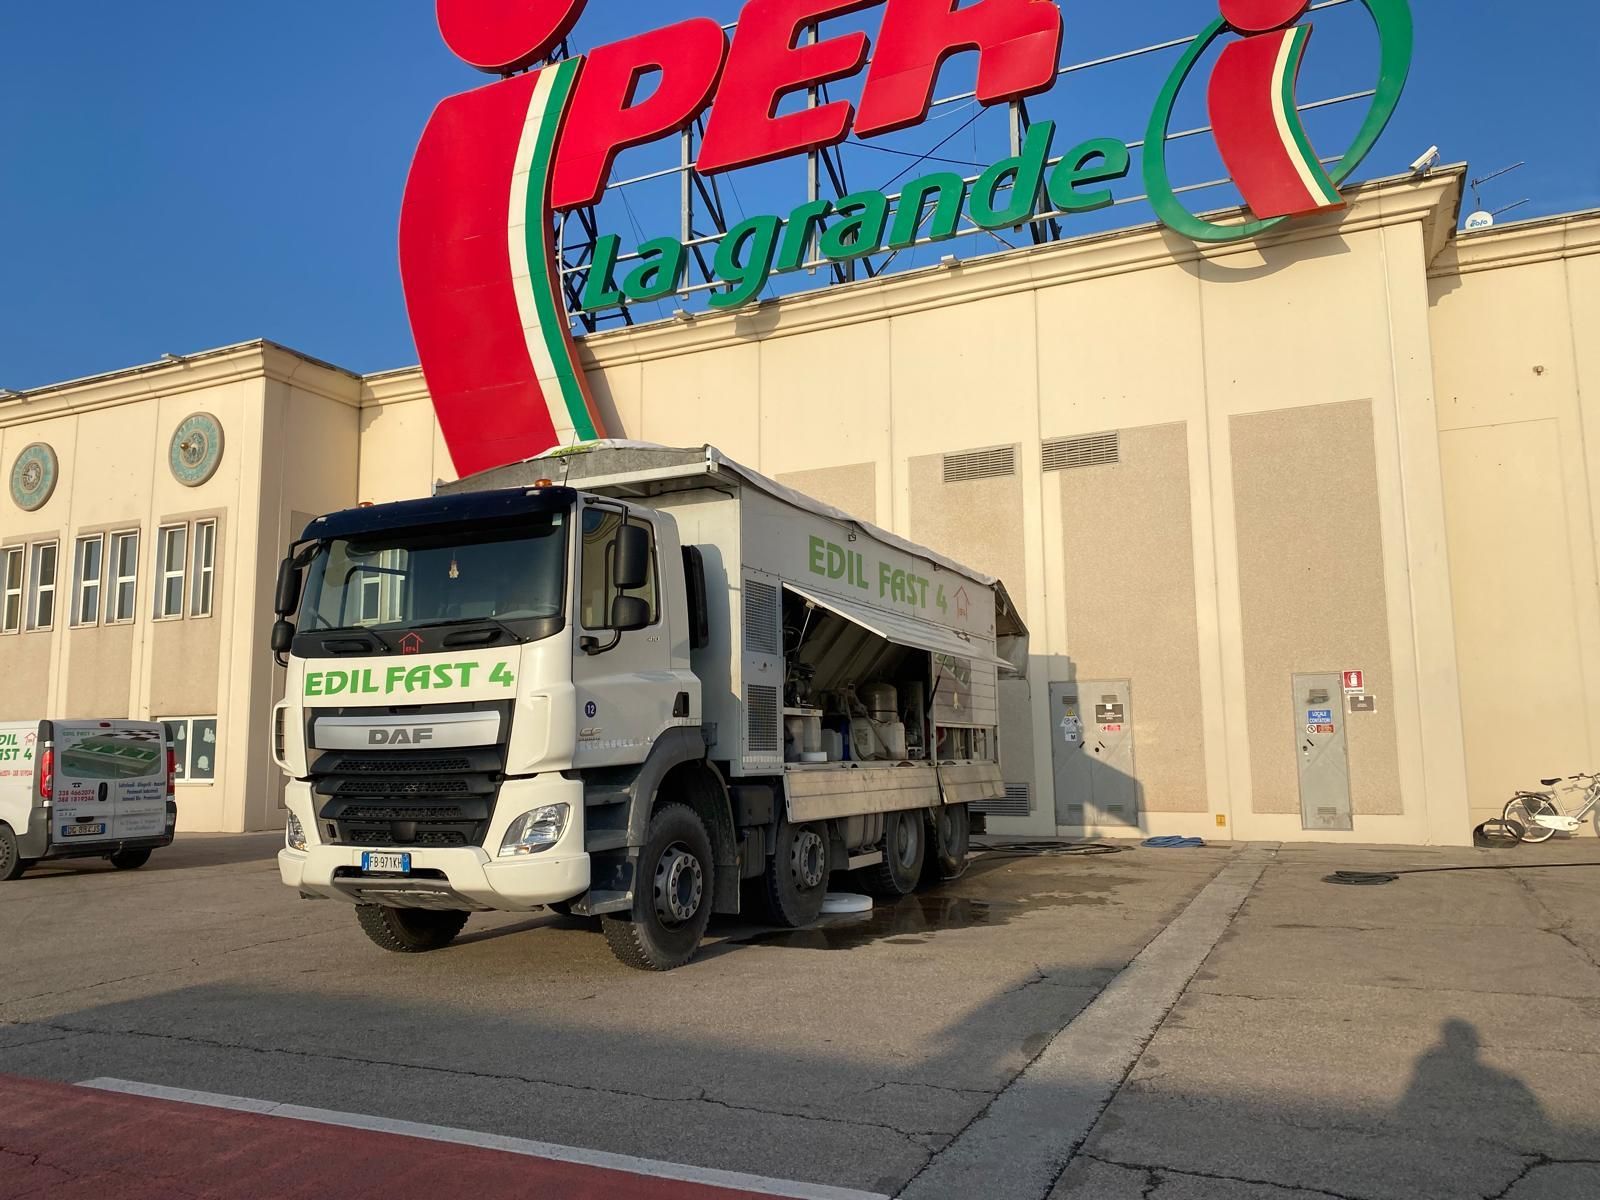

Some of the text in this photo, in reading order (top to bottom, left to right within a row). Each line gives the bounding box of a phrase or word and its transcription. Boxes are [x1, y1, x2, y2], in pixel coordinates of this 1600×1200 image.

[580, 120, 1131, 312] La grande
[808, 534, 948, 615] EDIL FAST 4
[304, 661, 515, 697] EDIL FAST 4
[586, 704, 596, 715] 12
[367, 726, 434, 746] DAF
[23, 747, 33, 761] 4
[369, 856, 403, 869] FB 971KH
